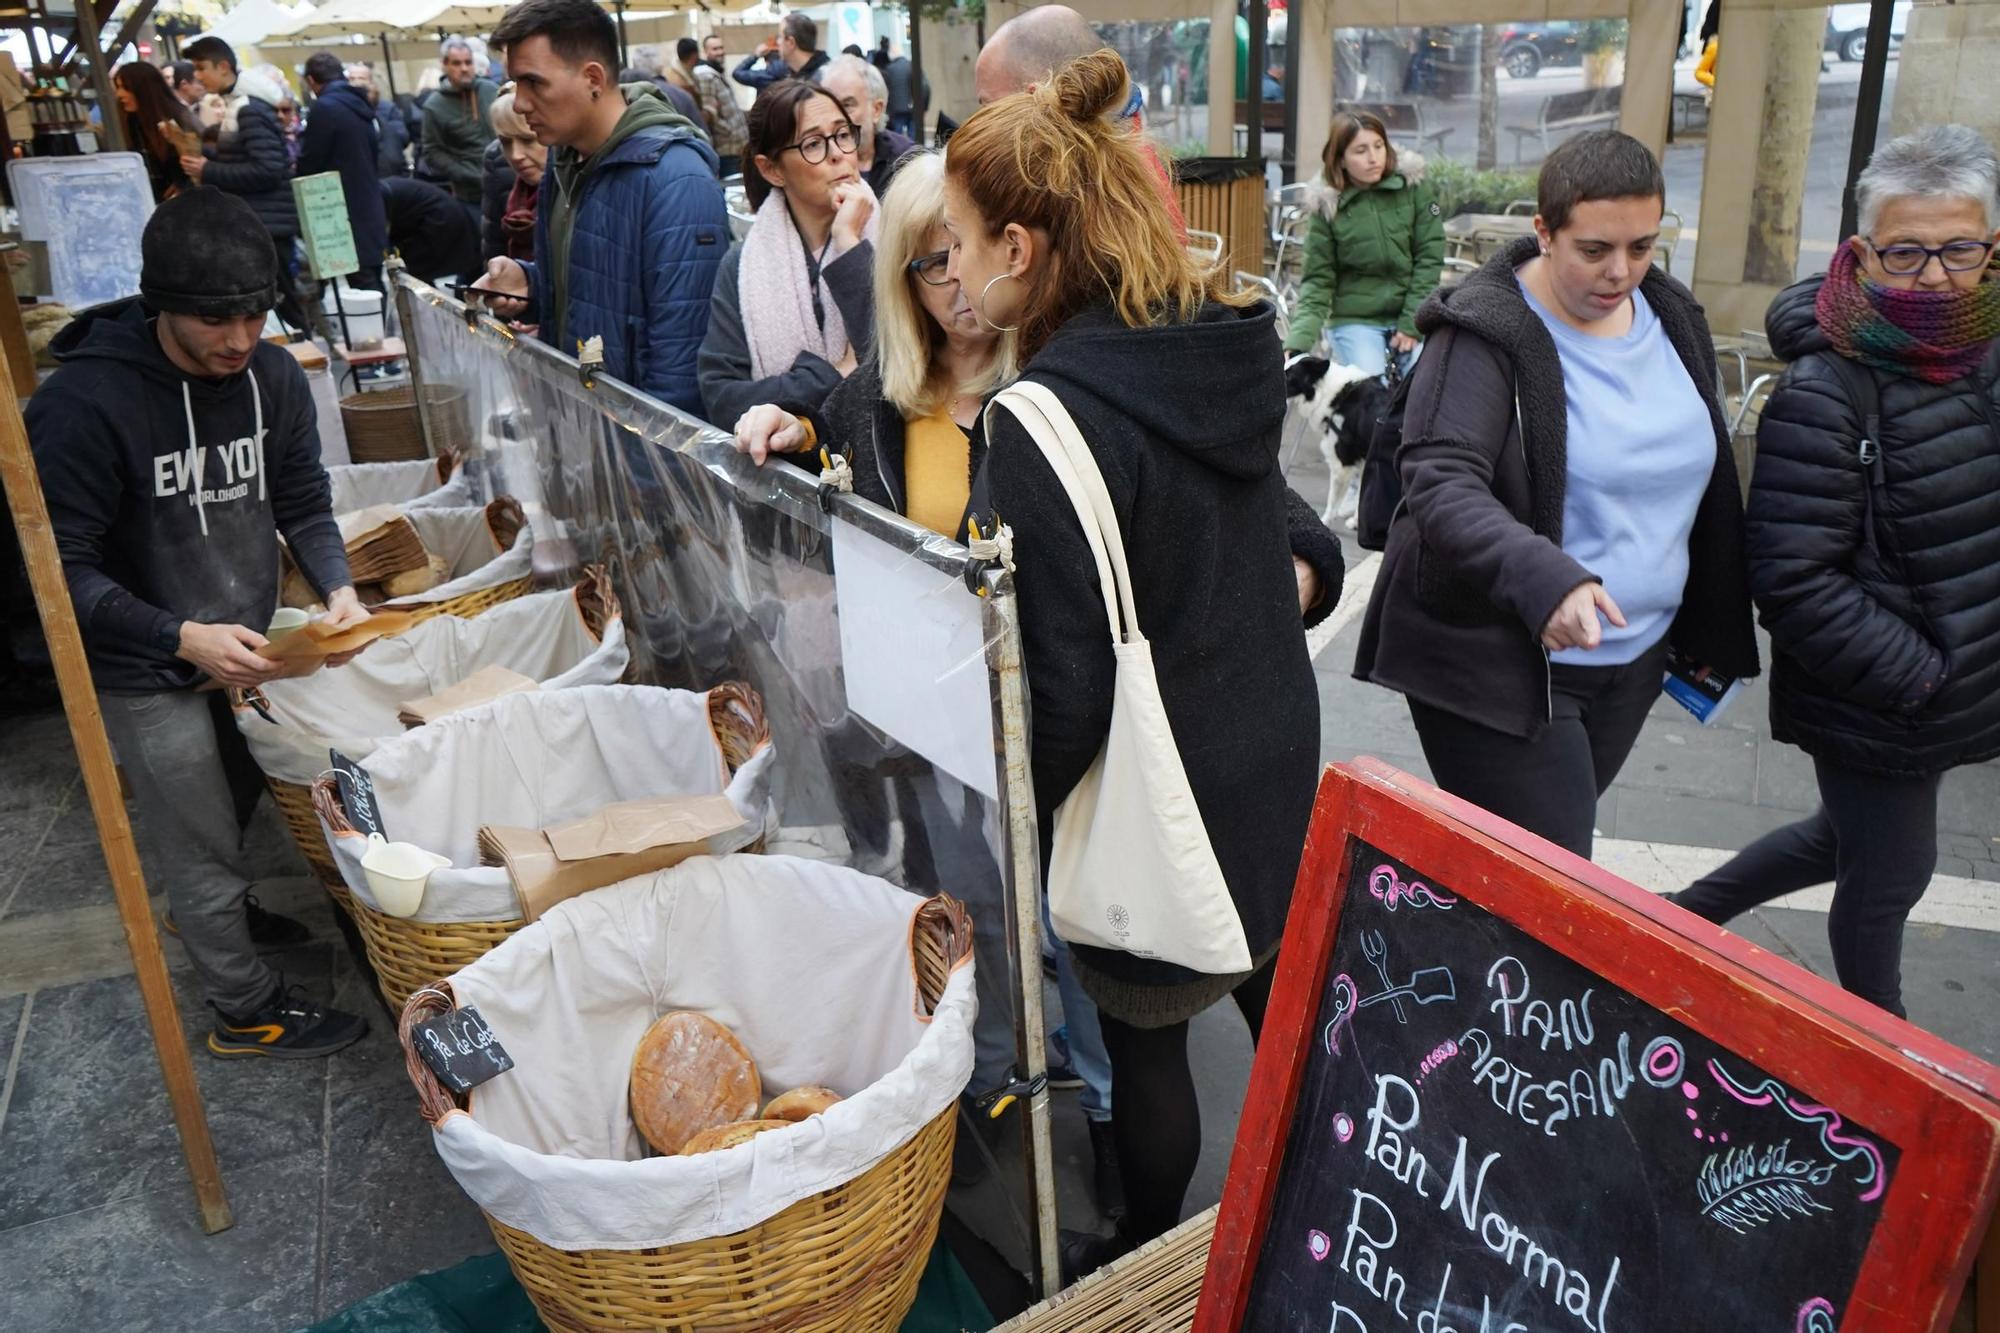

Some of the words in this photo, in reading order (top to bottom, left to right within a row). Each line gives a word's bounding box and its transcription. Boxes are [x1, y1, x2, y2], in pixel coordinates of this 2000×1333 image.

[153, 446, 207, 497] EW
[425, 1028, 455, 1062] Pa
[447, 1027, 474, 1056] de
[1487, 955, 1596, 1051] PAN
[1457, 1030, 1687, 1137] ARTESANO
[1364, 1073, 1429, 1197] Pan
[1439, 1135, 1621, 1333] Normal
[1339, 1188, 1409, 1321] Pan
